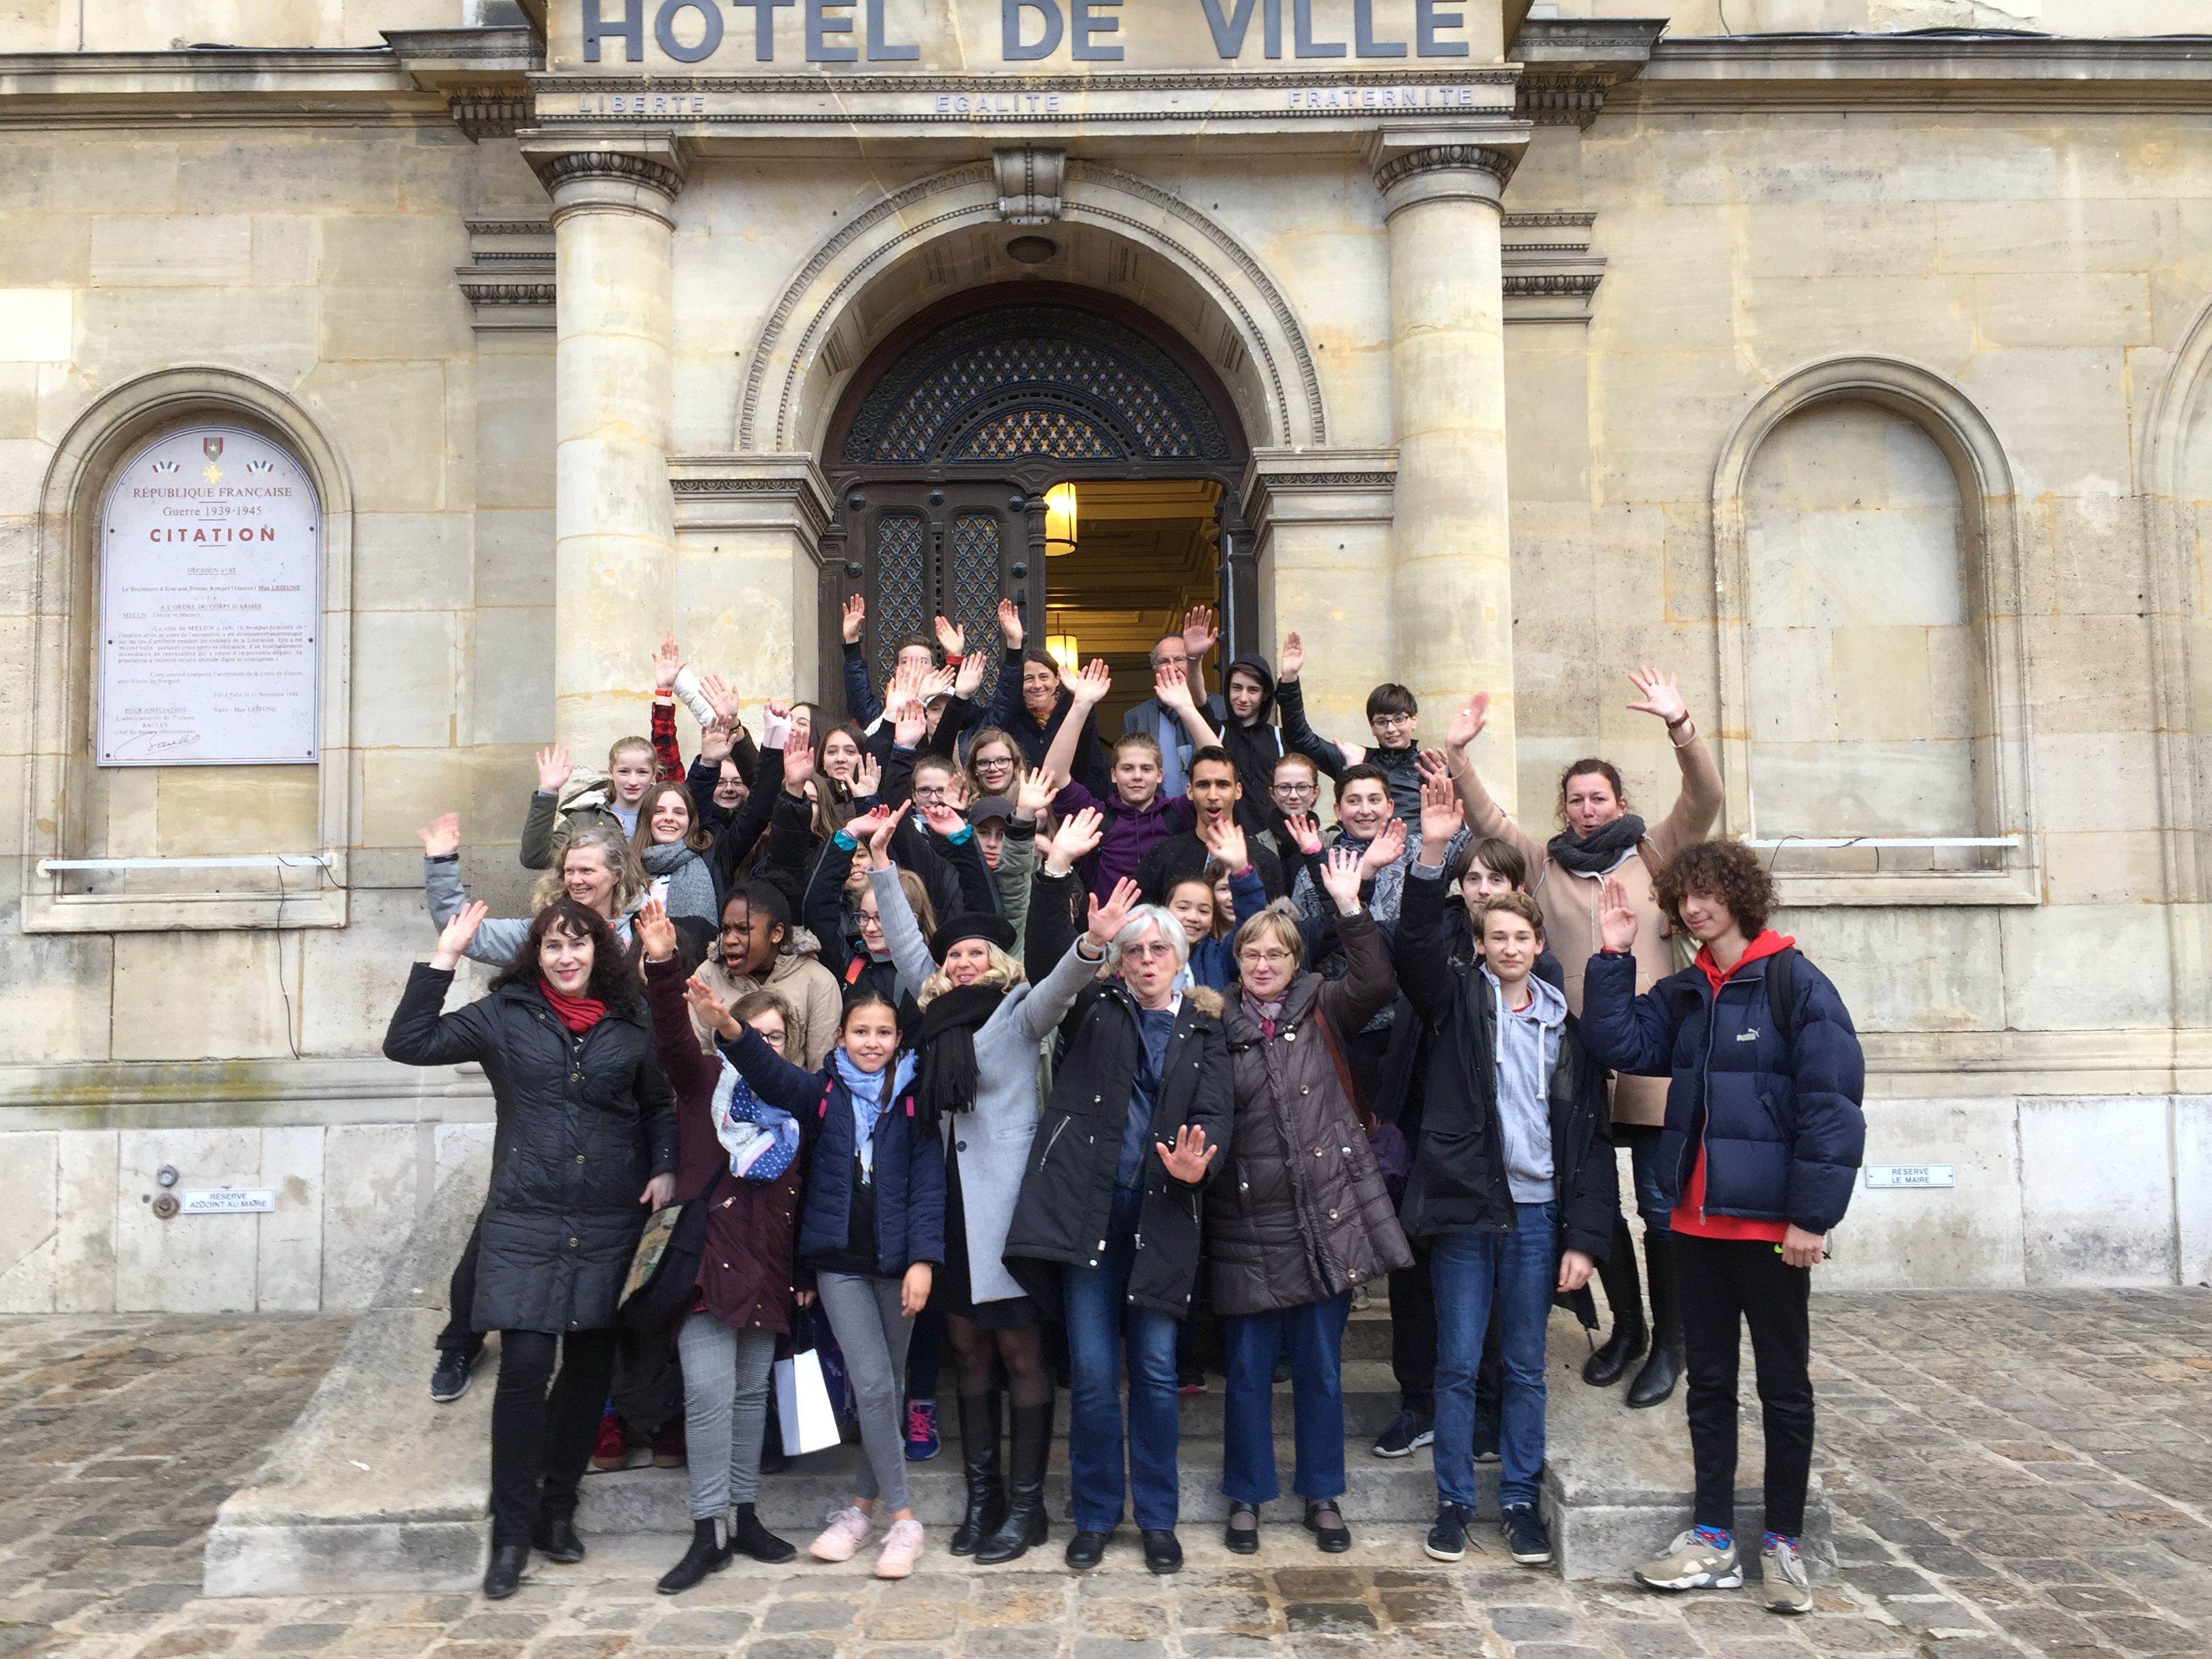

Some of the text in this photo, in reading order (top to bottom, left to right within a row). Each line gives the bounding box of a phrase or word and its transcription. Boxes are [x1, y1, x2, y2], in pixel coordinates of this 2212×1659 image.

[1002, 0, 1124, 61] DE
[1201, 0, 1469, 59] VILLE
[579, 96, 705, 112] LIBERTE
[936, 94, 1061, 112] EGALITE
[1288, 88, 1473, 108] FRATERNITE
[133, 486, 292, 499] RÉPUBLIQUE FRANÇAISE
[163, 506, 262, 516] Guerre 1939-1945
[150, 527, 275, 542] CITATION
